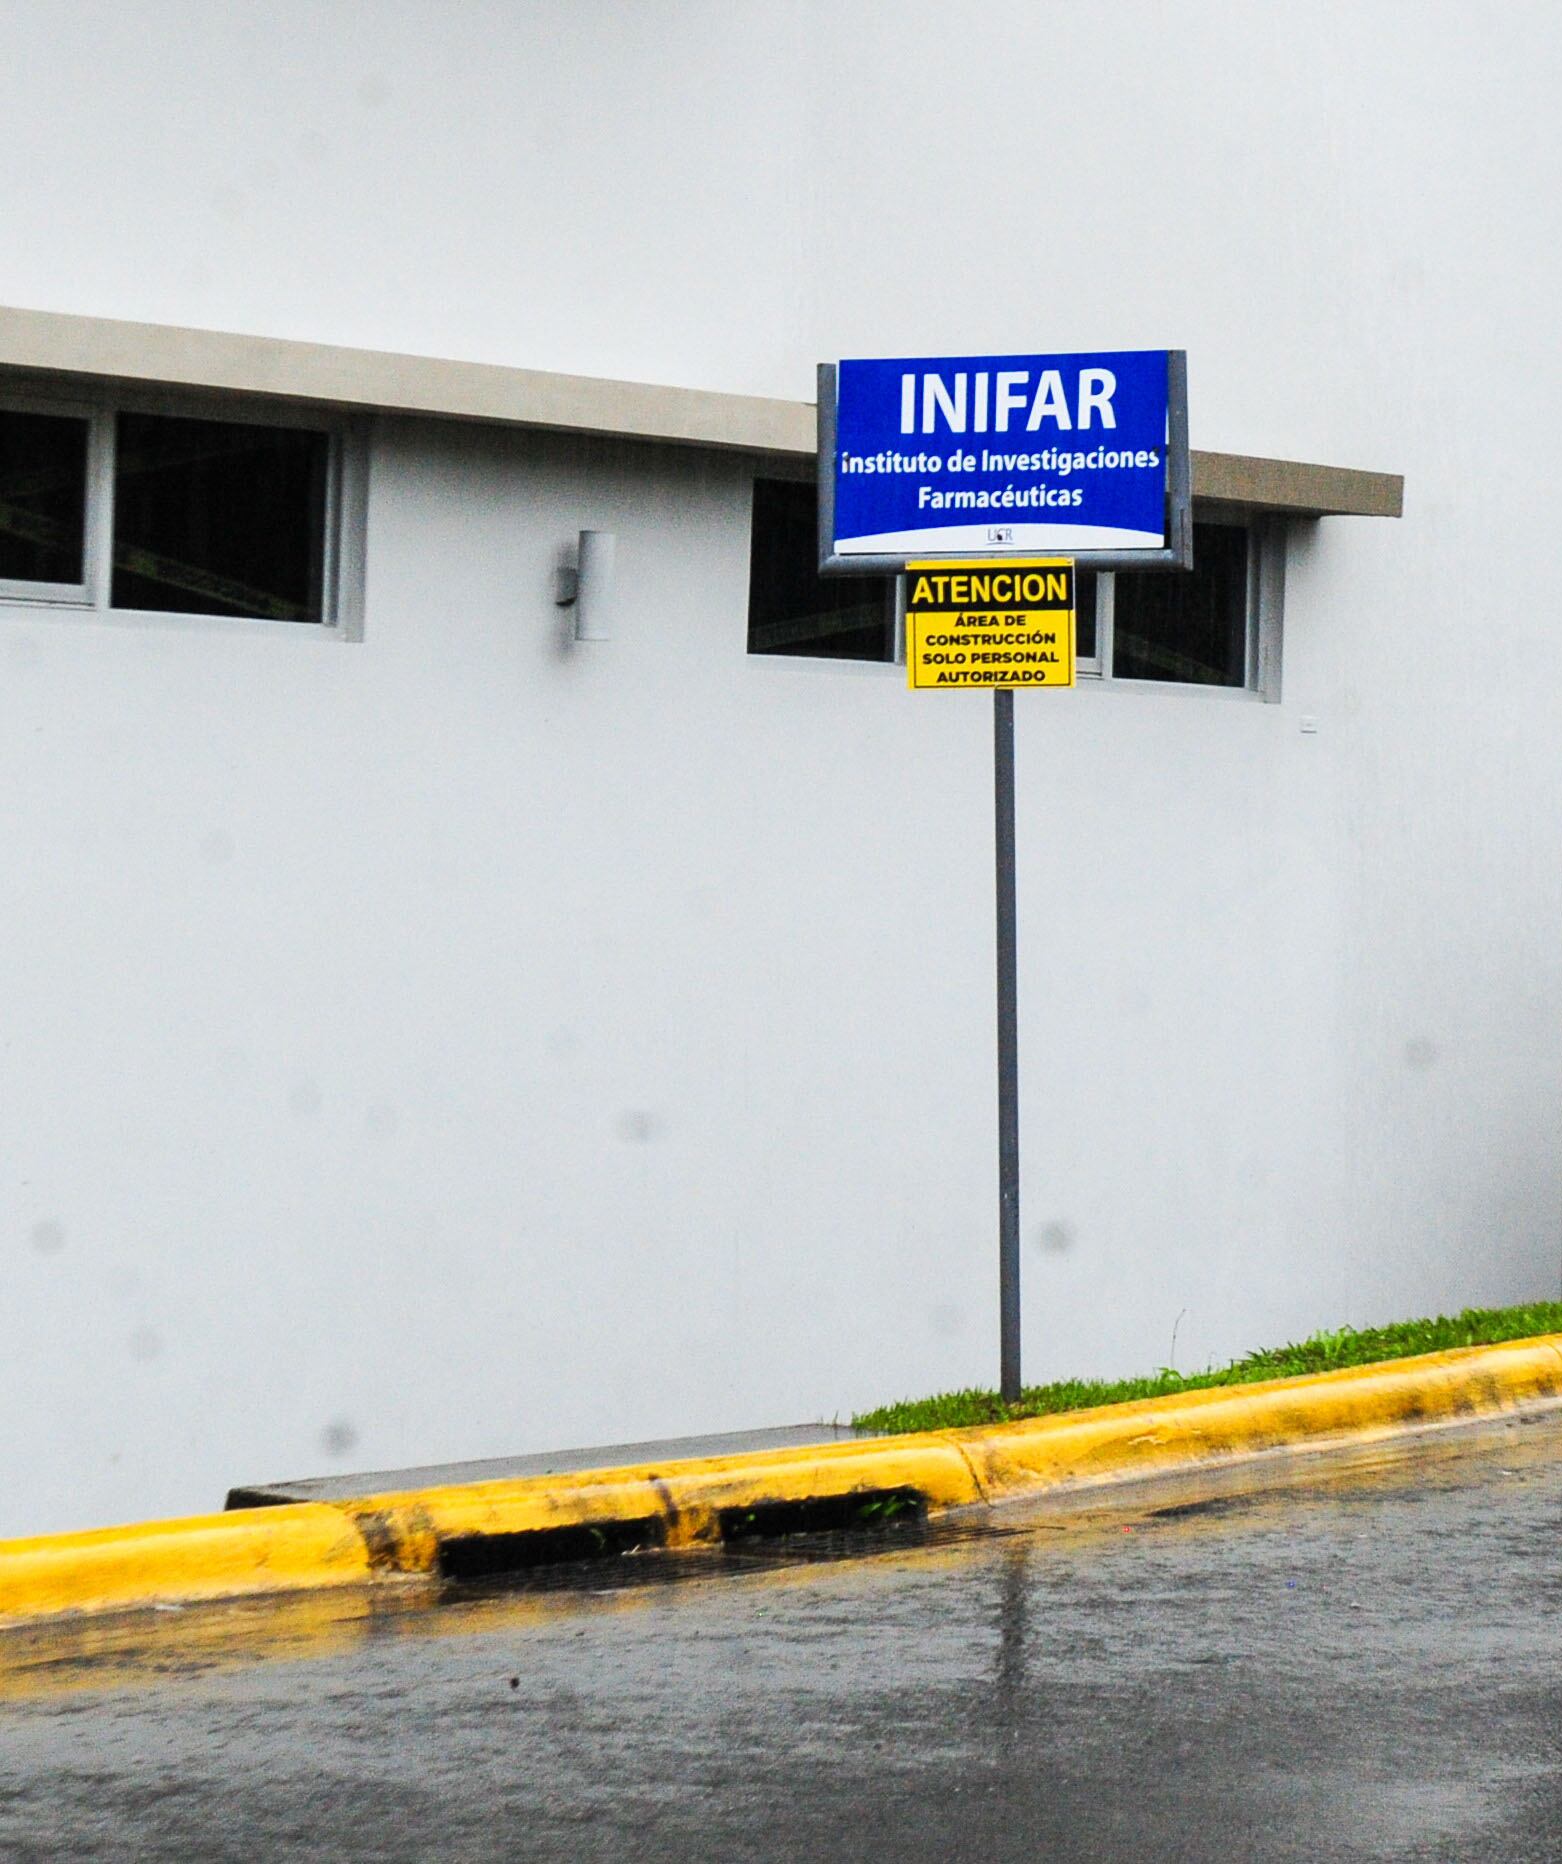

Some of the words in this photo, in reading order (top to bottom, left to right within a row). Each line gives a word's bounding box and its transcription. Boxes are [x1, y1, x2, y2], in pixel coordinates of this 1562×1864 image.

[901, 368, 1117, 434] INIFAR
[947, 449, 976, 473] de
[982, 446, 1159, 476] Investigaciones
[918, 483, 1083, 510] Farmacéuticas
[912, 573, 1067, 604] ATENCION
[955, 612, 999, 627] ÁREA
[1004, 614, 1026, 627] DE
[925, 630, 1056, 646] CONSTRUCCIÓN
[922, 652, 966, 665] SOLO
[971, 651, 1059, 664] PERSONAL
[936, 670, 1046, 683] AUTORIZADO
